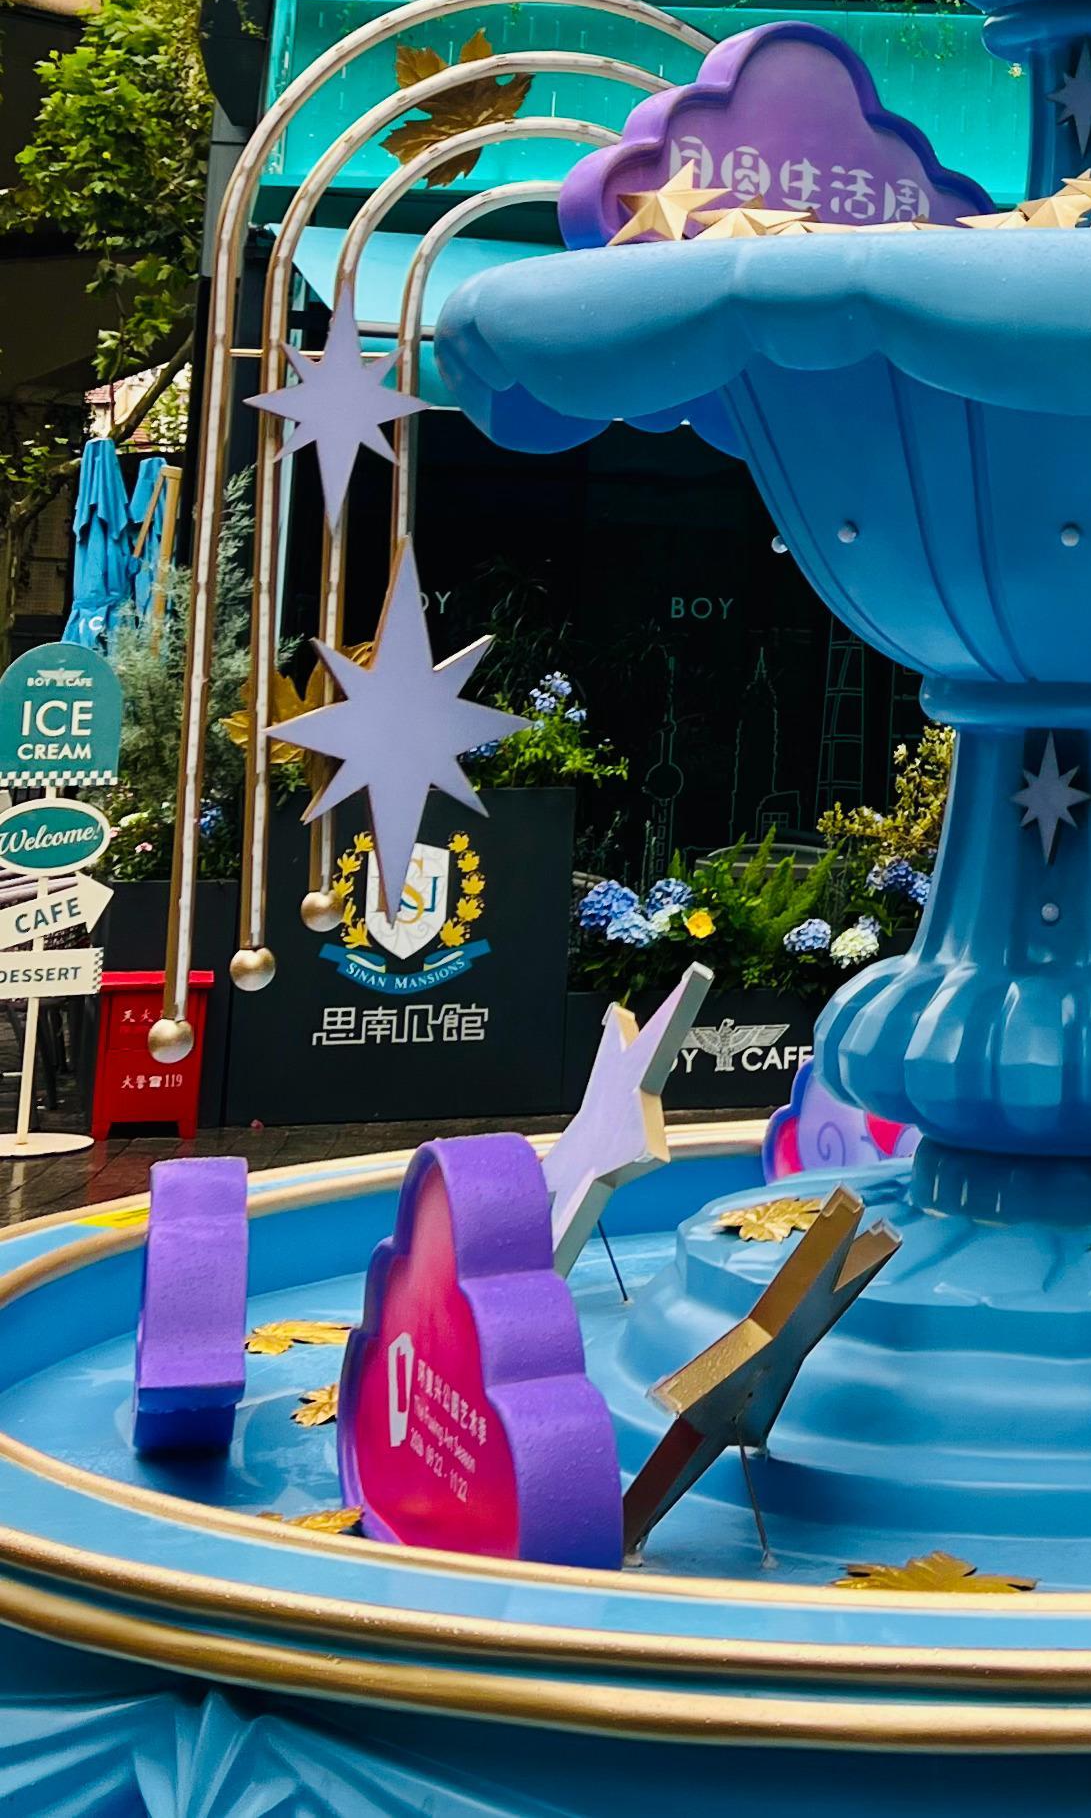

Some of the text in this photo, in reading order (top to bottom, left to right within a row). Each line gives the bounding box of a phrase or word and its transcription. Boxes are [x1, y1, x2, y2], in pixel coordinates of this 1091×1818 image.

[670, 597, 735, 619] BOY
[27, 677, 93, 687] BOY CAFE
[21, 700, 94, 737] ICE
[17, 743, 92, 760] CREAM
[0, 824, 102, 855] Welcome!
[15, 897, 82, 934] CAFE
[0, 966, 82, 983] DESSERT
[346, 962, 386, 988] SINAN
